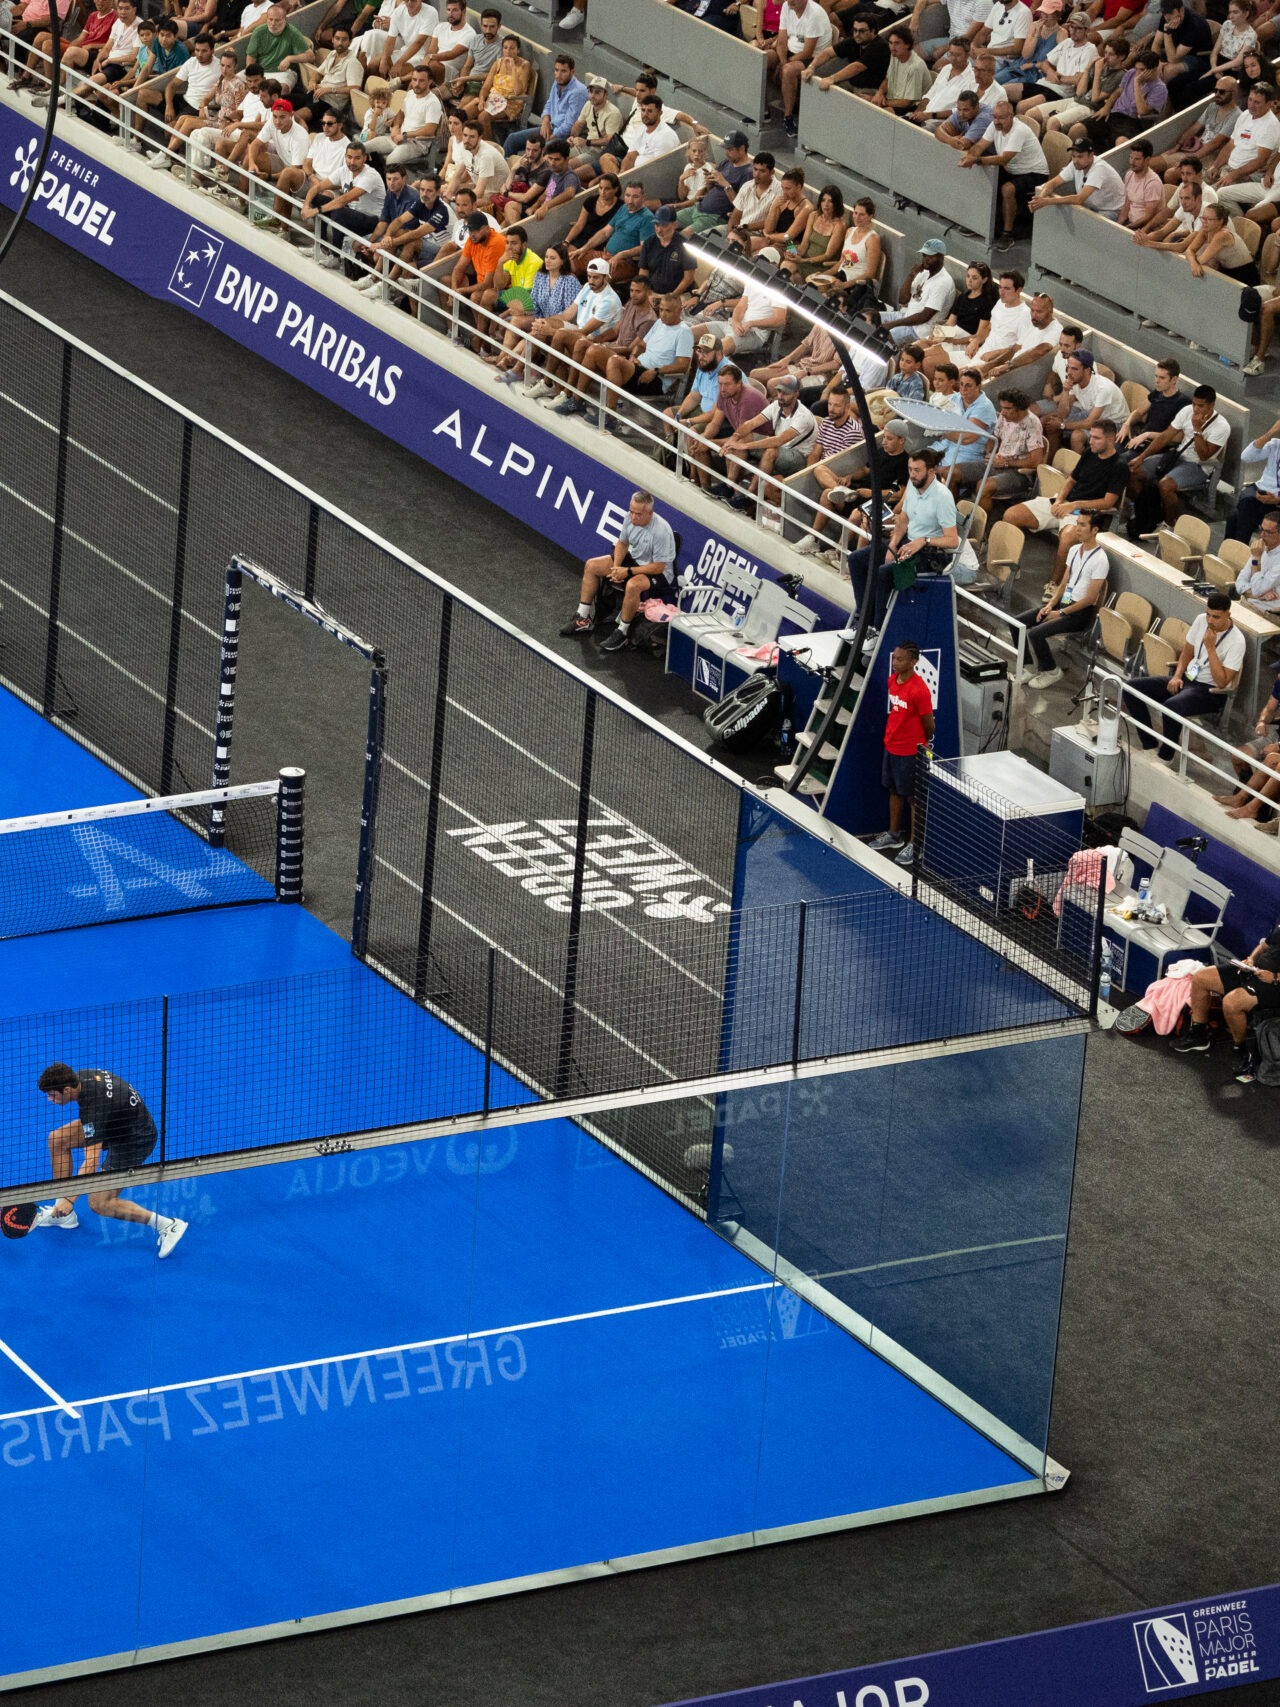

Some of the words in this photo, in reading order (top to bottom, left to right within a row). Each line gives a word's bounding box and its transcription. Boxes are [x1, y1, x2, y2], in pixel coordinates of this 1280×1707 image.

[50, 150, 100, 188] PREMIER
[32, 170, 117, 246] PADEL
[214, 263, 279, 324] BNP
[275, 300, 403, 406] PARIBAS
[432, 408, 631, 547] ALPINE
[1193, 1601, 1246, 1617] GREENWEEZ
[1194, 1612, 1252, 1641] PARIS
[1199, 1633, 1257, 1658] MAJOR
[1204, 1650, 1257, 1666] PREMIER
[1205, 1659, 1260, 1681] PADEL
